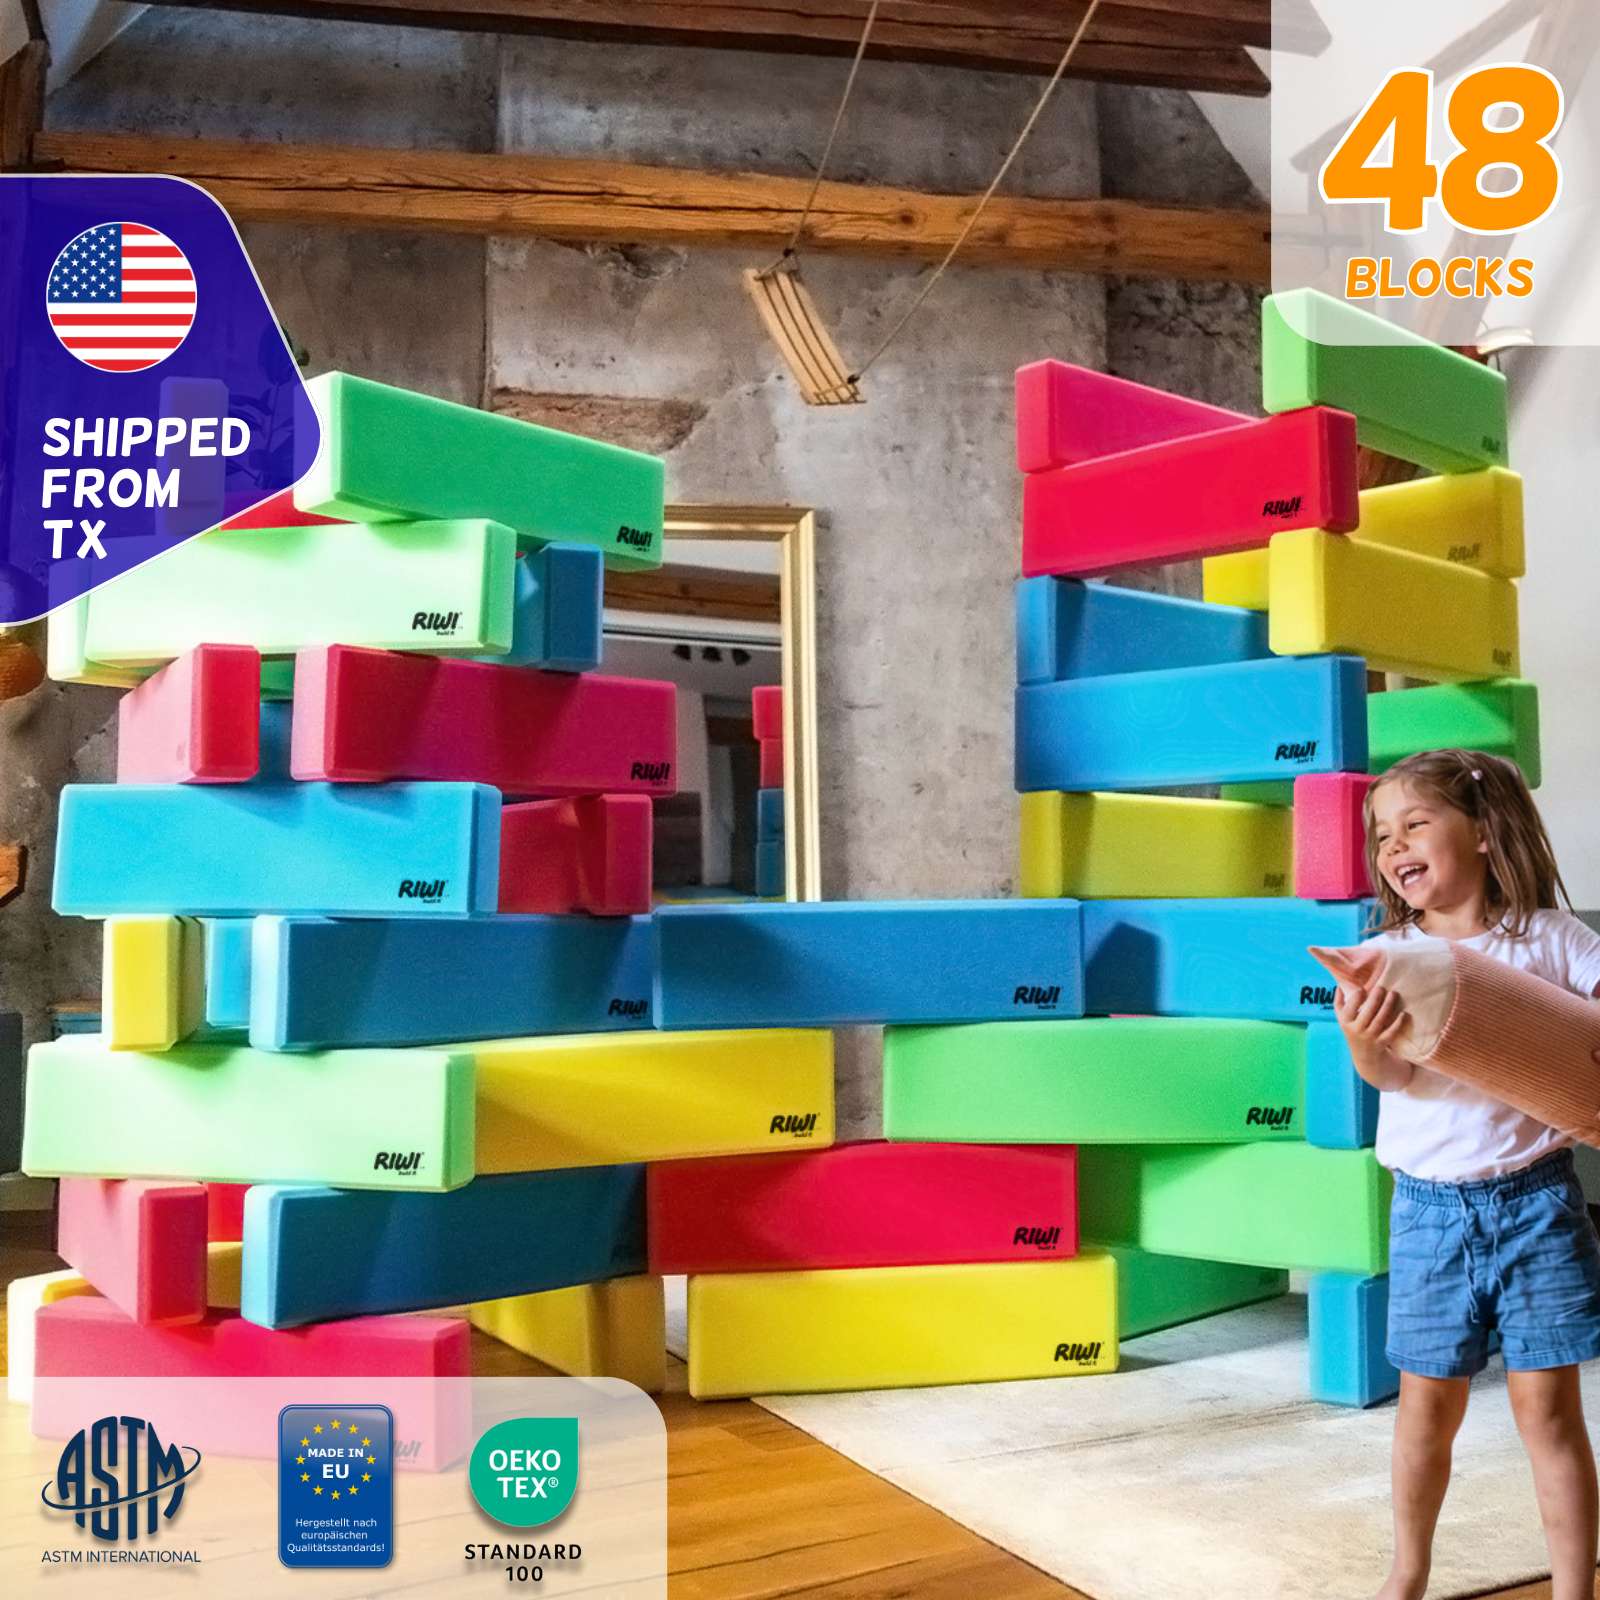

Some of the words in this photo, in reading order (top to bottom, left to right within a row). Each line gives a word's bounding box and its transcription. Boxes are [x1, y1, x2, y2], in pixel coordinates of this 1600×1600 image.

[1262, 496, 1302, 516] RIWI
[617, 526, 653, 547] RIWI
[412, 612, 460, 630] RIWI
[1275, 741, 1317, 760] RIWI
[631, 762, 670, 780] RIWI
[398, 880, 446, 898] RIWI
[1014, 986, 1061, 1004] RIWI
[1300, 986, 1338, 1004] RIW
[608, 999, 649, 1016] RIWI
[770, 1114, 817, 1133] RIWI
[1246, 1107, 1294, 1125] RIWI
[374, 1152, 421, 1170] RIWI
[1013, 1227, 1060, 1245] RIWI
[1054, 1342, 1102, 1361] RIWI
[394, 1440, 422, 1458] IWI
